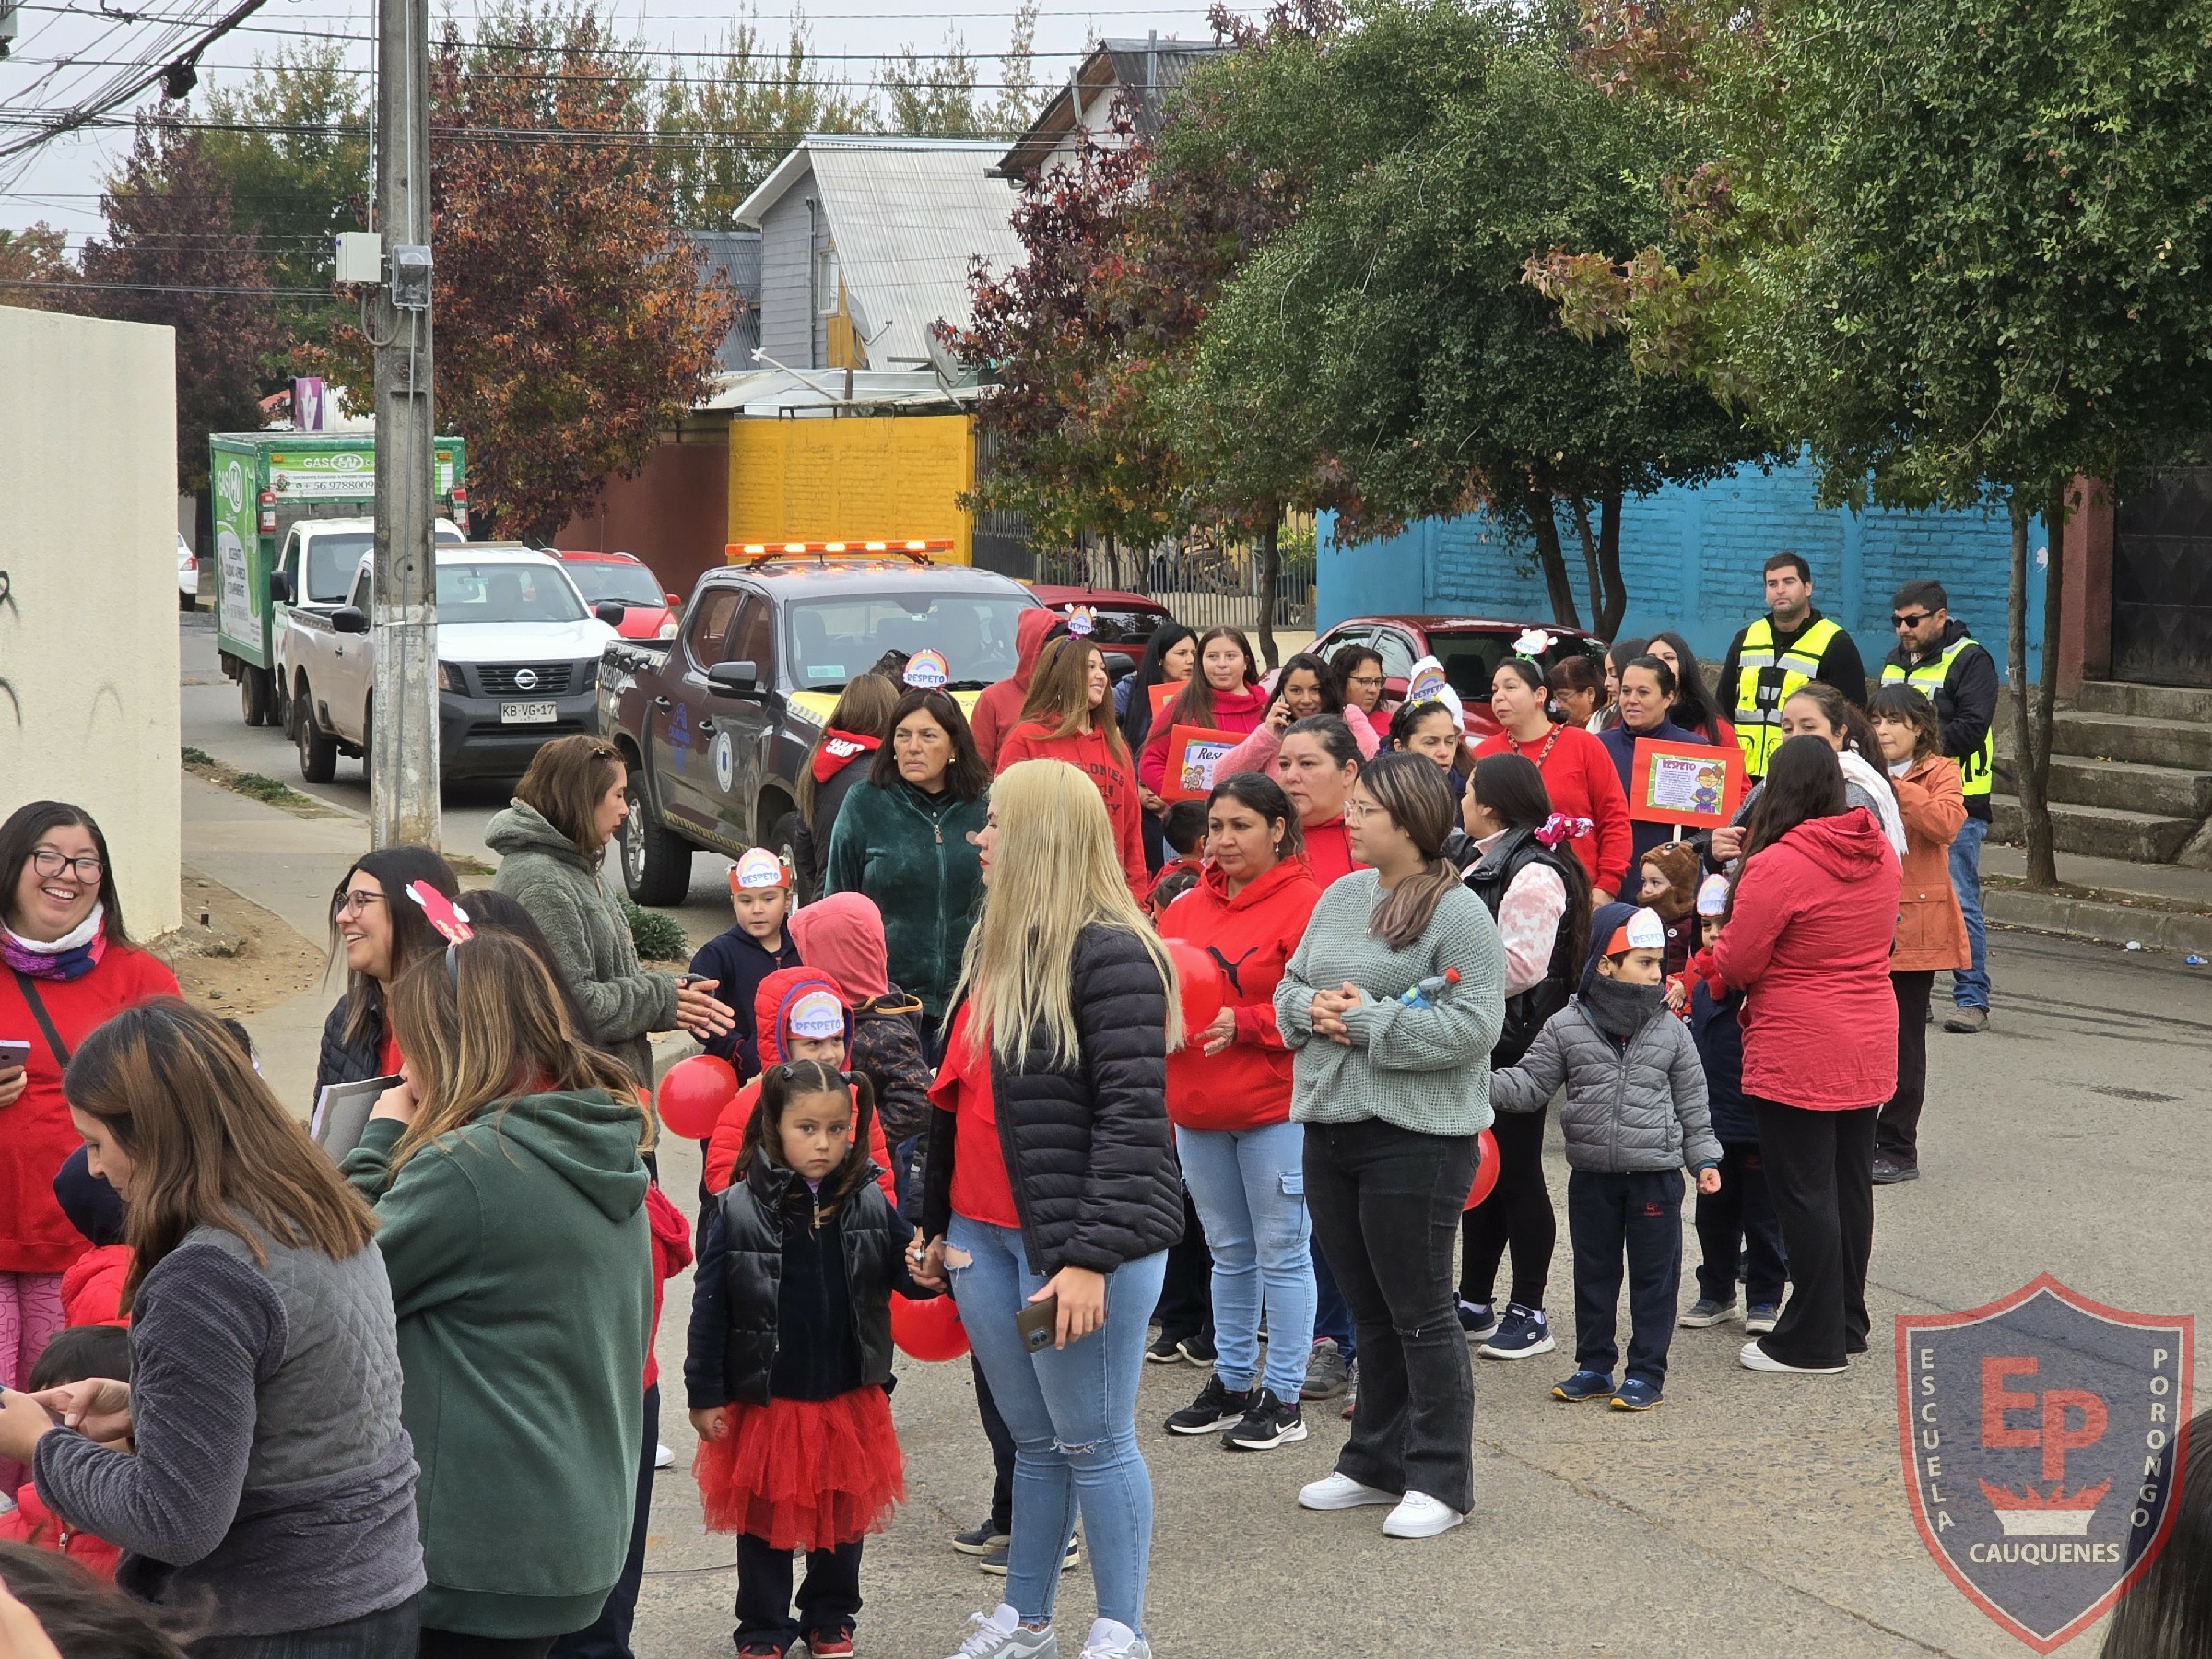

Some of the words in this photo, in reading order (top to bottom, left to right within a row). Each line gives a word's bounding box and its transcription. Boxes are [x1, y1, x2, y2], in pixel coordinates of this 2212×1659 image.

[303, 458, 329, 468] GAS
[313, 481, 327, 490] 56
[907, 673, 946, 684] RESPETO
[1413, 683, 1445, 700] RESPETO
[1662, 759, 1697, 771] RESPETO
[741, 872, 779, 885] RESPETO
[795, 1018, 841, 1031] RESPETO
